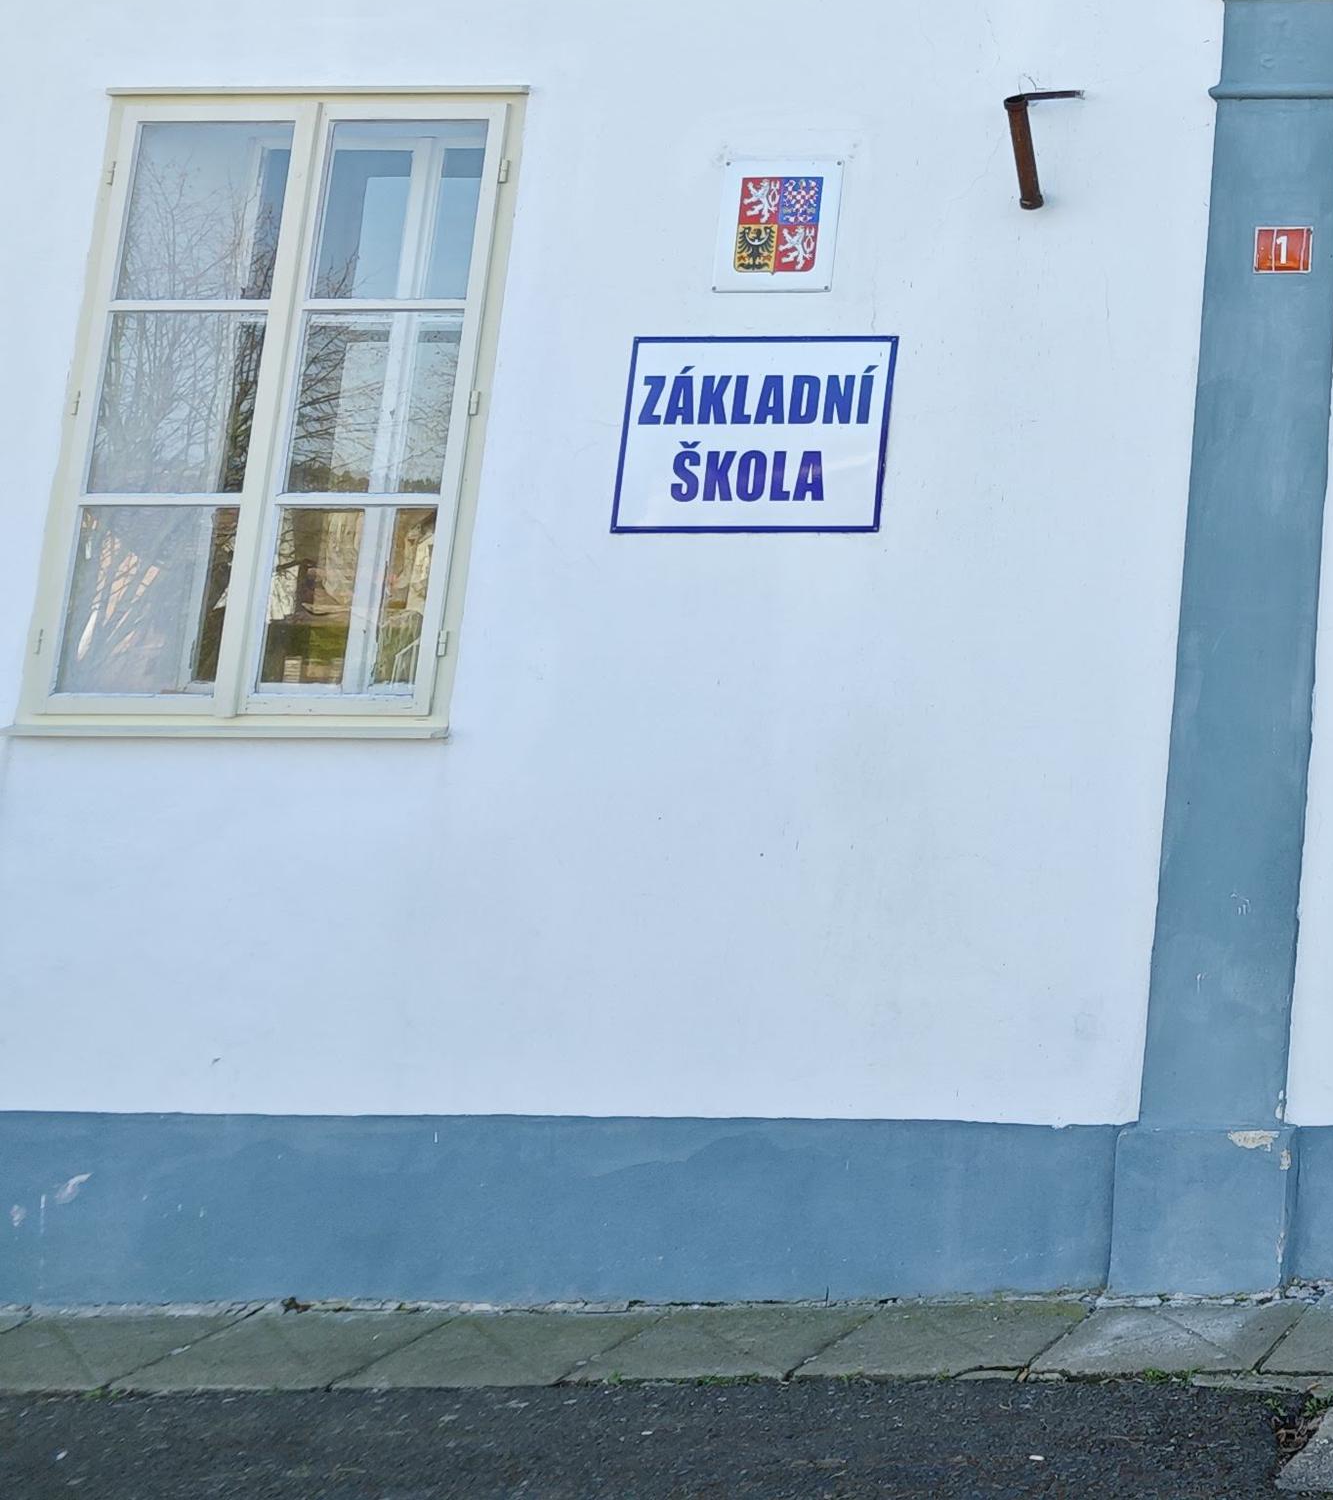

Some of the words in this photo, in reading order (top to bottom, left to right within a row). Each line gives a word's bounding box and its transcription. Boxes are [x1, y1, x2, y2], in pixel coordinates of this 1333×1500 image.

[1276, 235, 1288, 264] 1
[637, 365, 879, 425] ZÁKLADNÍ
[670, 441, 825, 502] ŠKOLA
